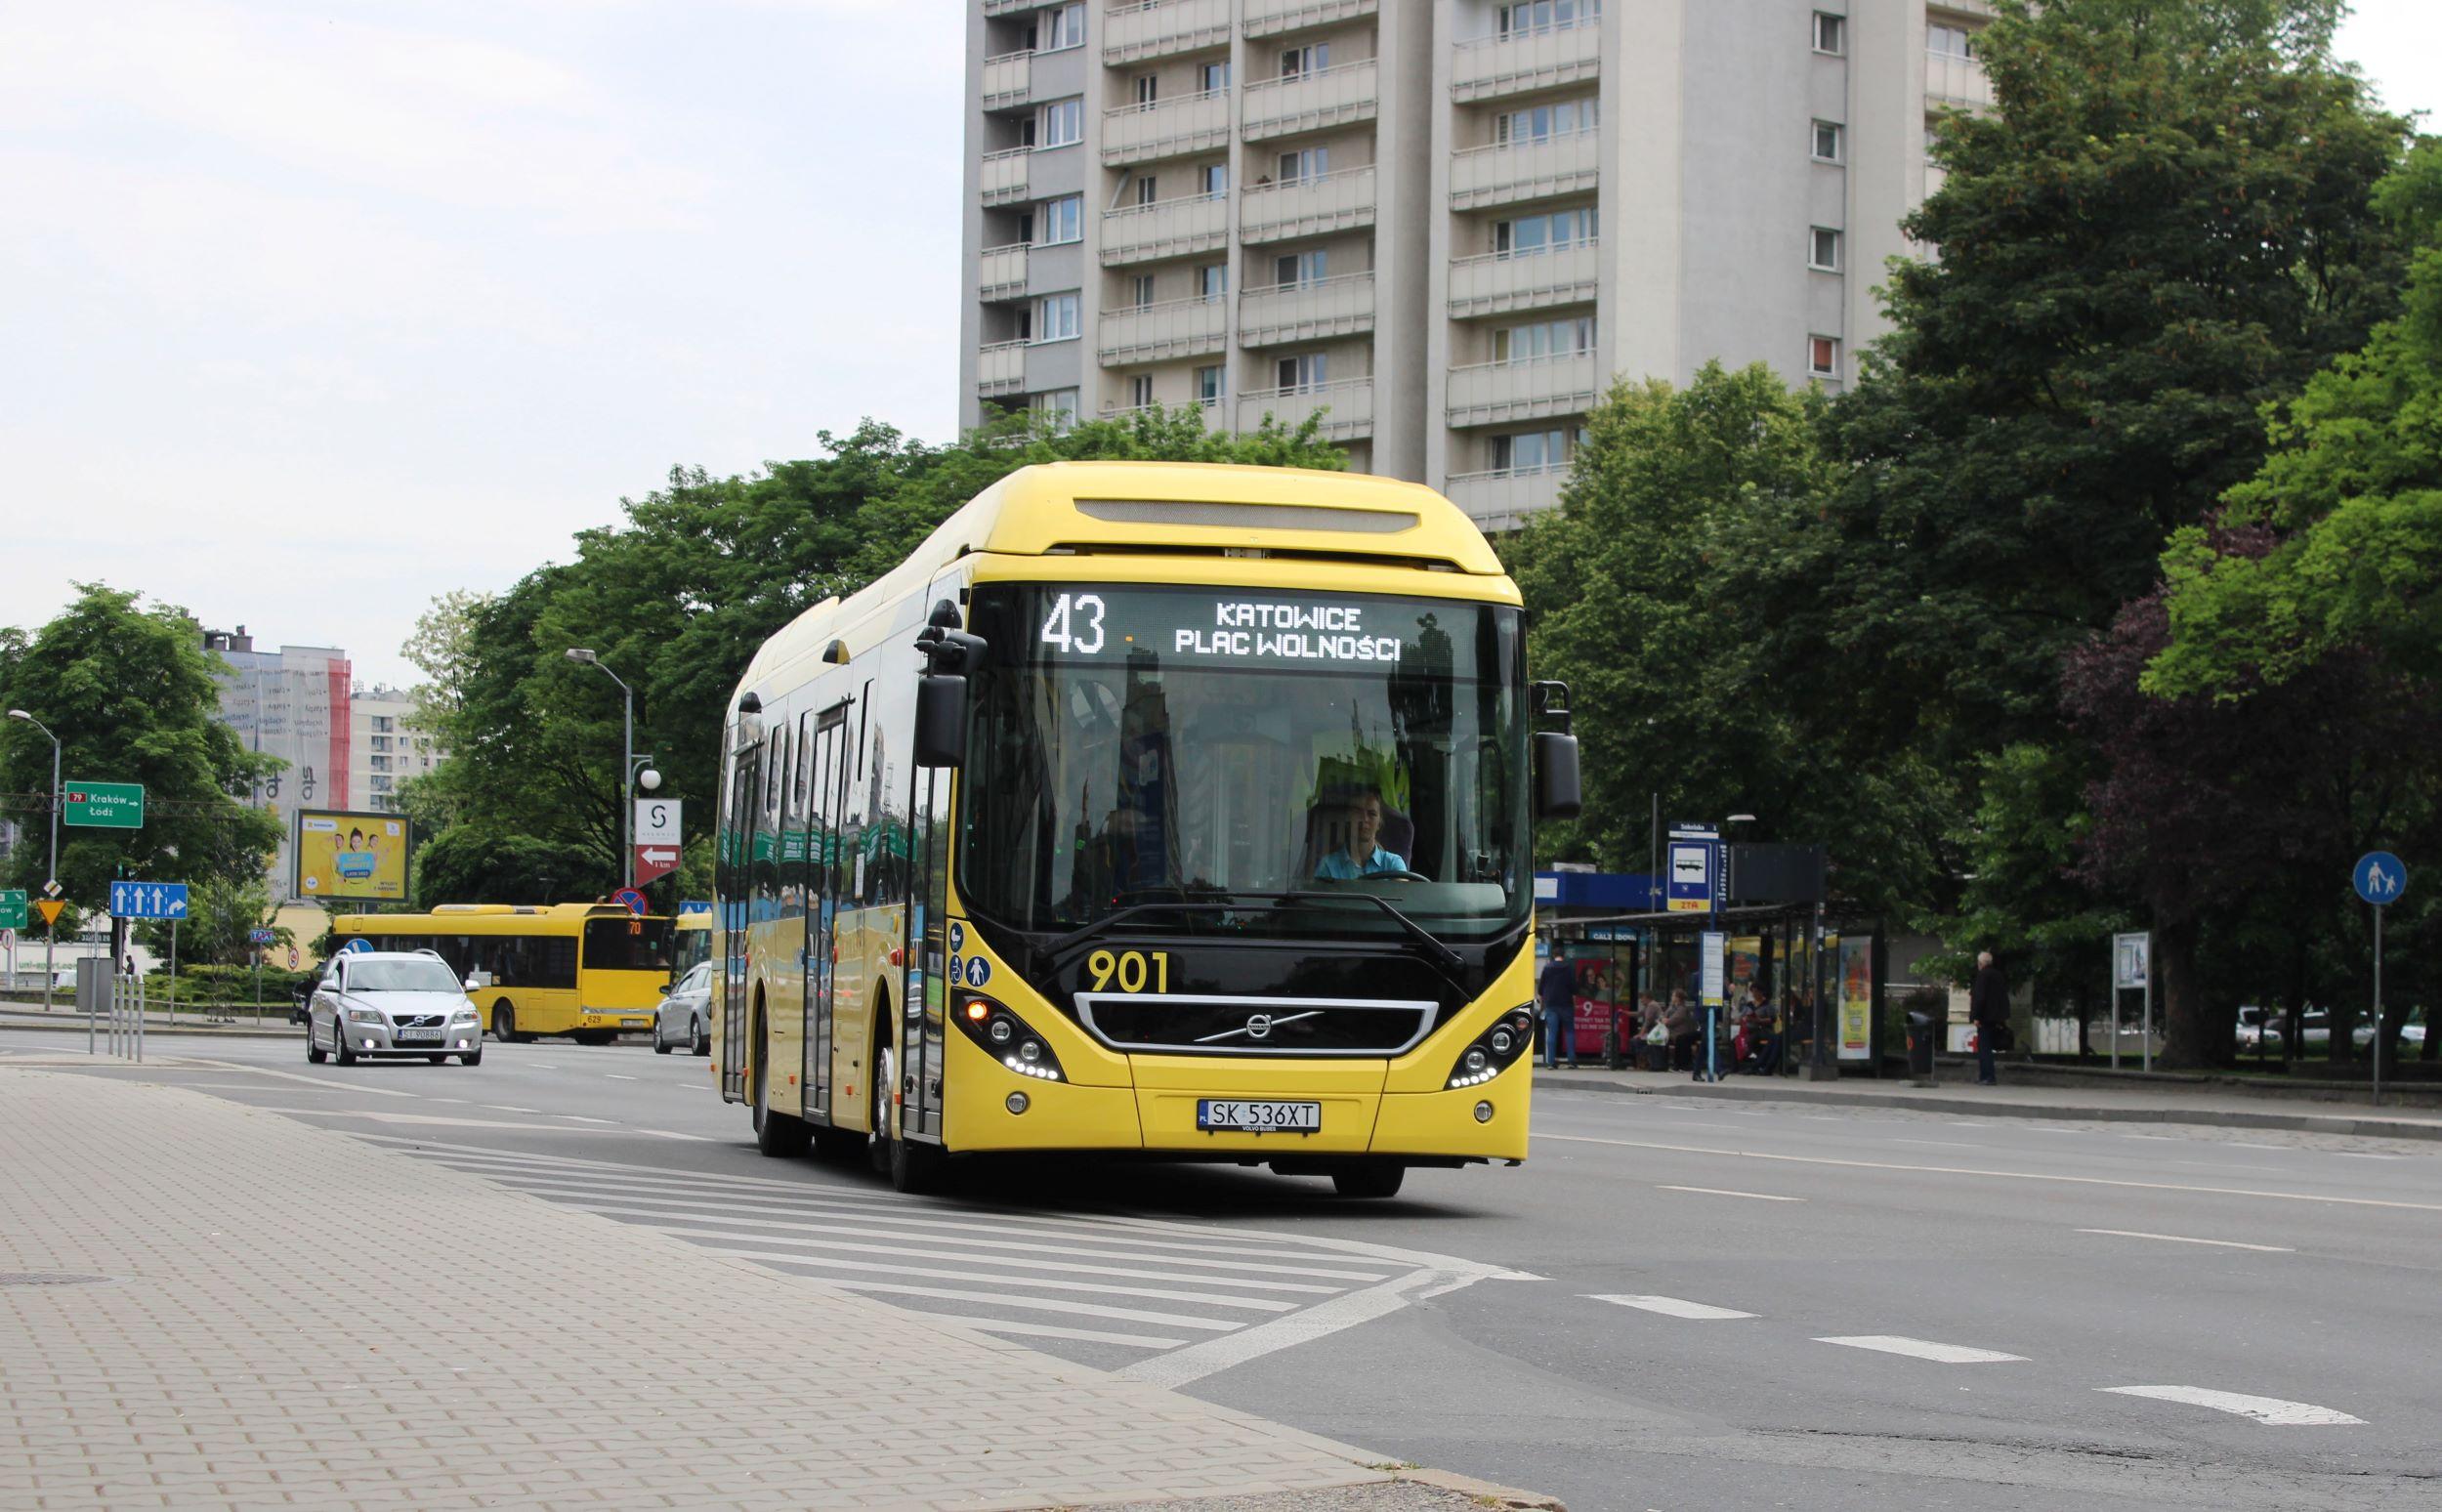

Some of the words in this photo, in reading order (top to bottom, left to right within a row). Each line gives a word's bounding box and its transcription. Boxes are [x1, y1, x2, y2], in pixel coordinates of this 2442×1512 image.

[1041, 593, 1105, 654] 43
[1216, 602, 1362, 632] KATOWICE
[1175, 629, 1250, 656] PLAC
[1256, 633, 1401, 662] WOLNOŚCI
[90, 793, 127, 805] Kraków
[90, 806, 113, 817] Łódź
[629, 921, 641, 936] 70
[1088, 949, 1167, 993] 901
[587, 1015, 602, 1024] 629
[1213, 1104, 1240, 1124] SK
[1248, 1105, 1314, 1126] 536XT
